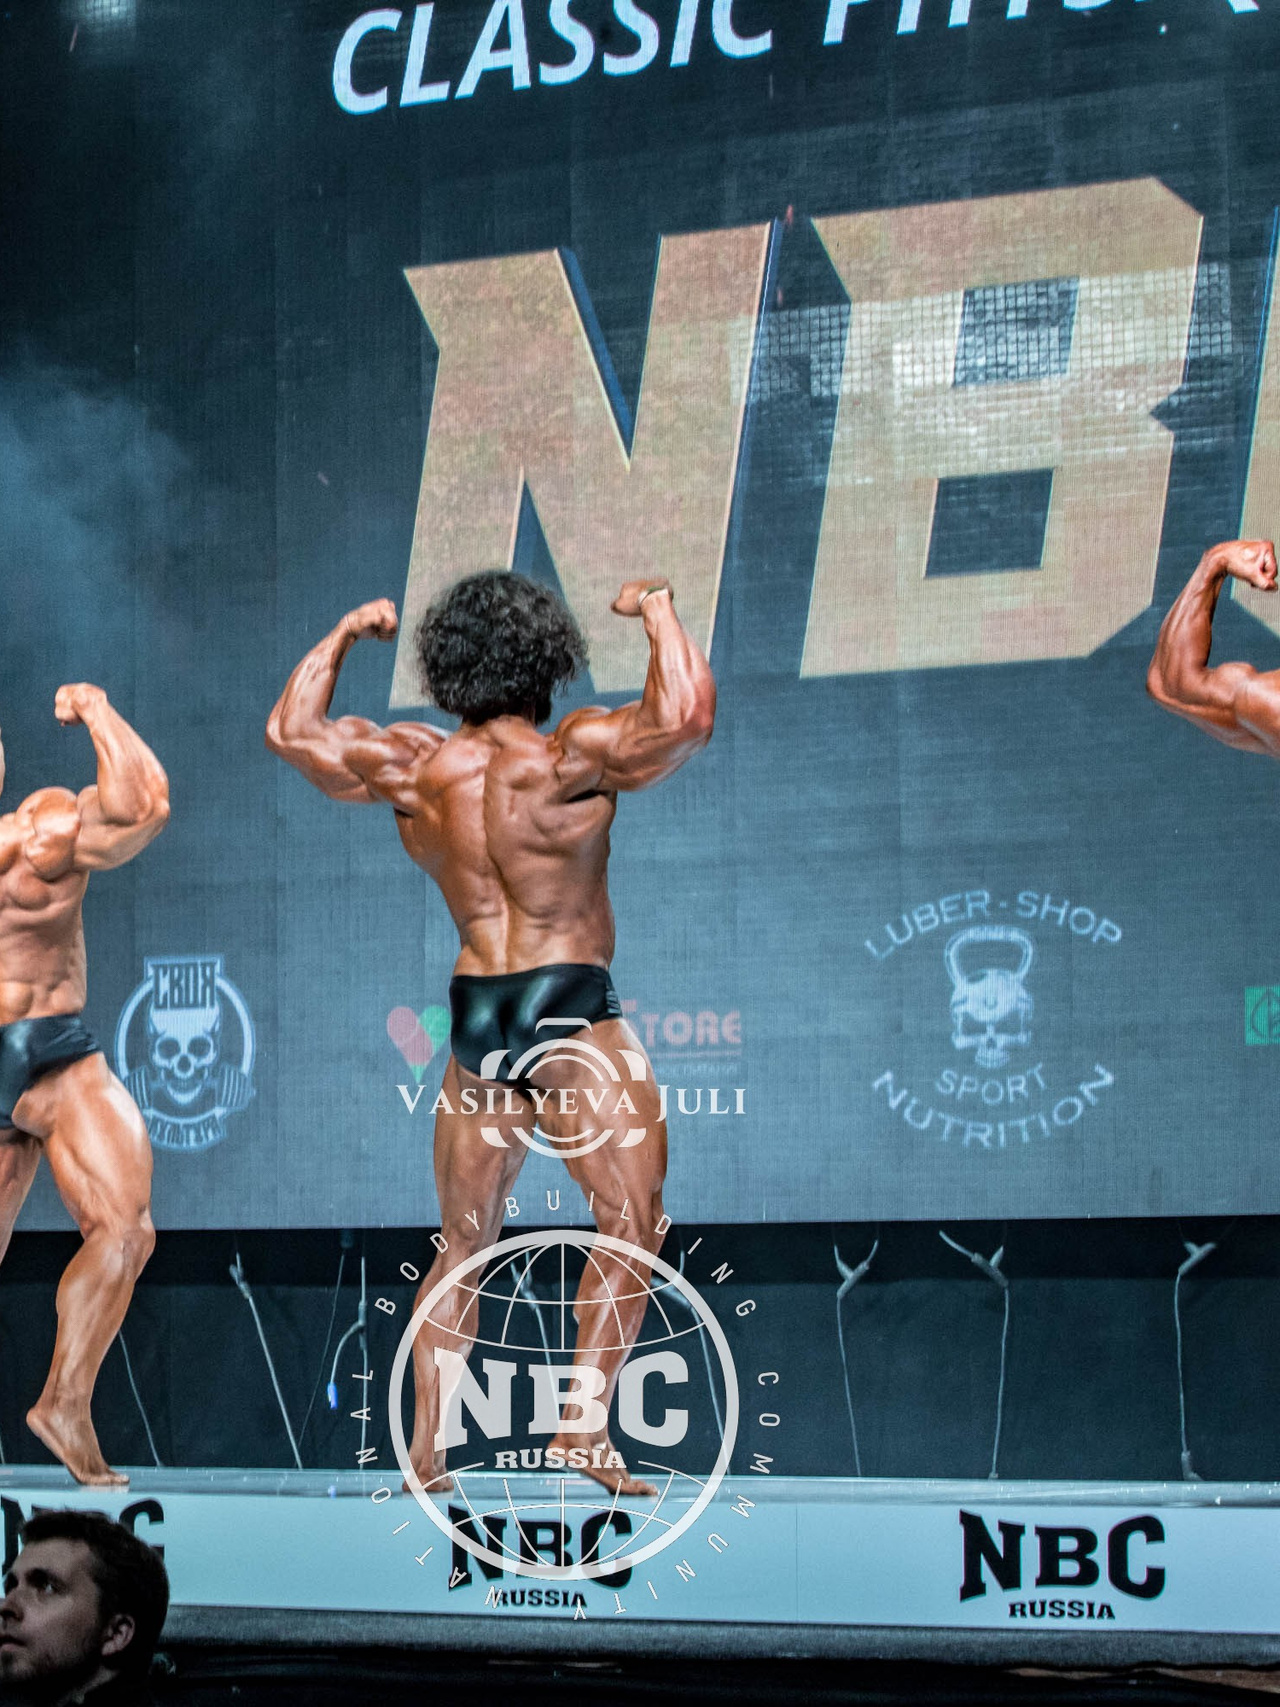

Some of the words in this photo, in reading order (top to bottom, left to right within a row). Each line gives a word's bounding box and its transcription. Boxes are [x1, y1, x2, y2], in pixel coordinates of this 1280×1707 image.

[331, 0, 773, 115] CLASSIC
[388, 176, 1280, 710] NB
[871, 1063, 1114, 1148] NUTRITION
[935, 1062, 1048, 1106] SPORT
[447, 1503, 633, 1592] NBC
[959, 1509, 1166, 1603] NBC
[494, 1588, 588, 1609] RUSSIA
[1008, 1598, 1116, 1620] RUSSIA
